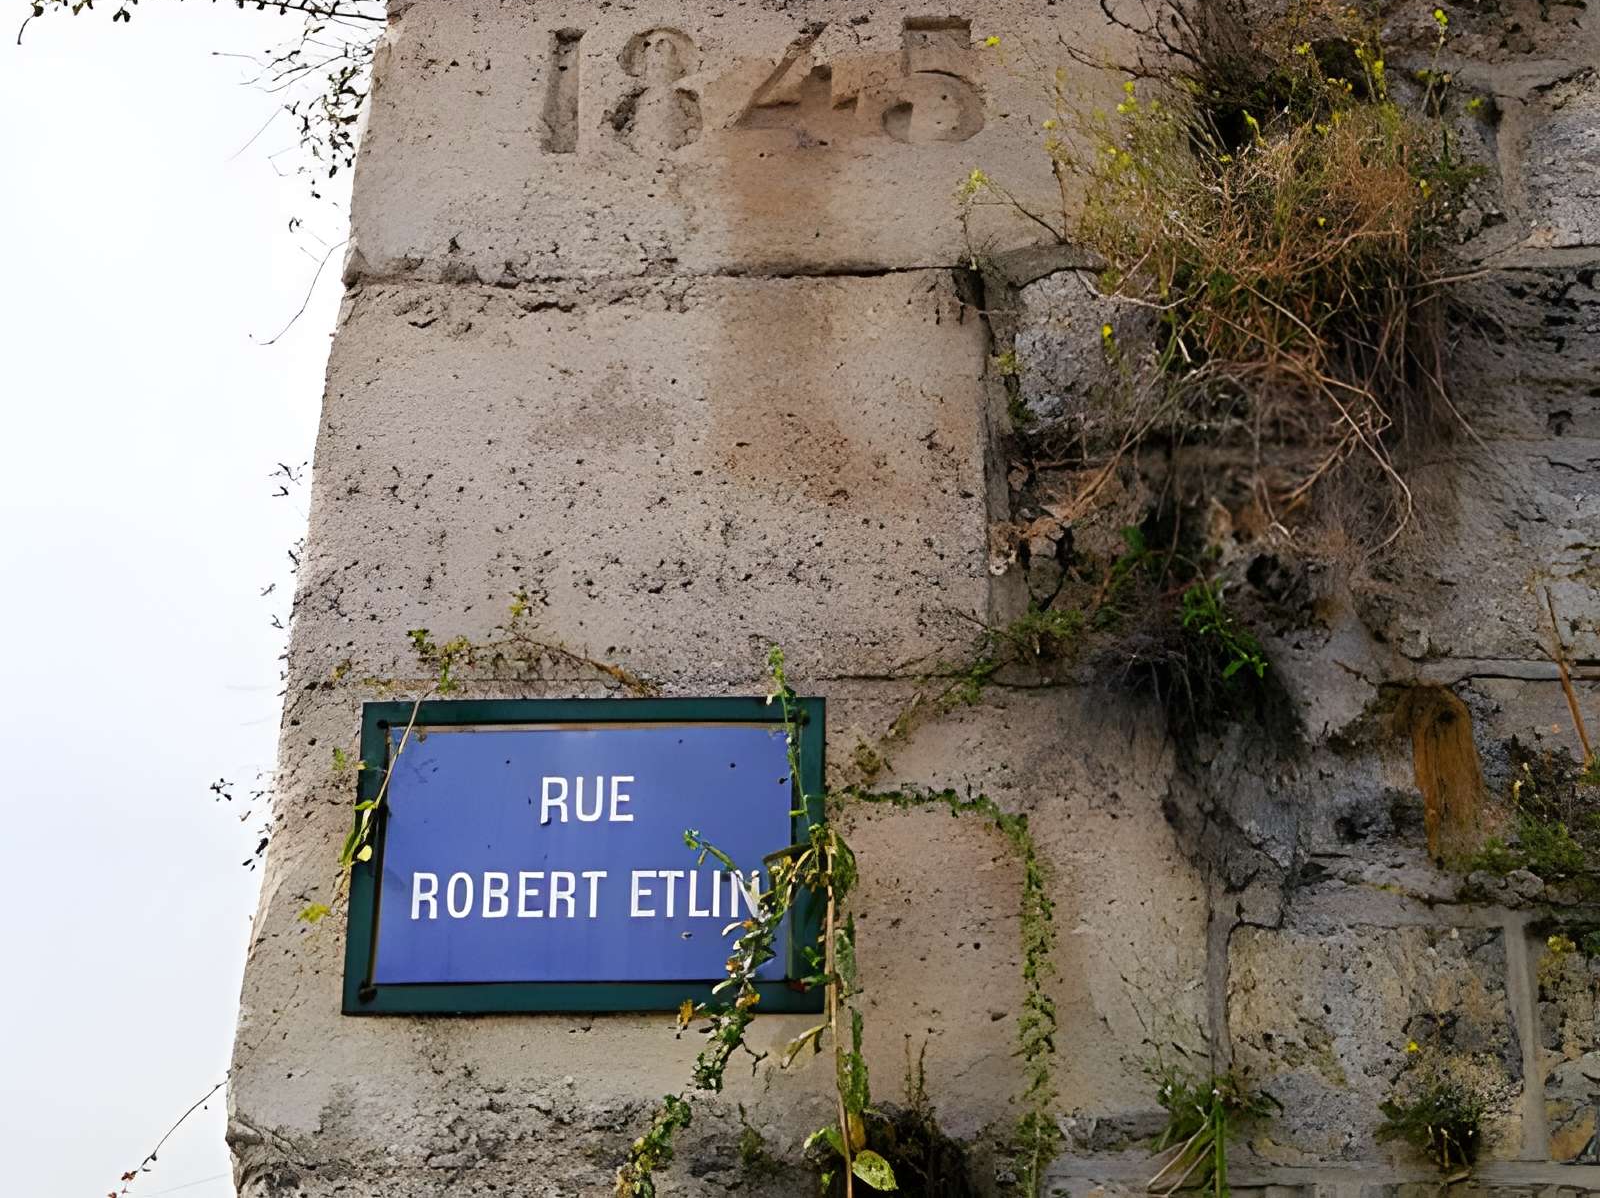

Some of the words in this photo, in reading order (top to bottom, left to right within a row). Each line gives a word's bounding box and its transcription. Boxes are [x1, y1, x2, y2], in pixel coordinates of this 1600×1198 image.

[541, 15, 986, 153] 1845
[540, 775, 635, 824] RUE
[411, 870, 608, 920] ROBERT
[630, 869, 761, 919] ETLIN
